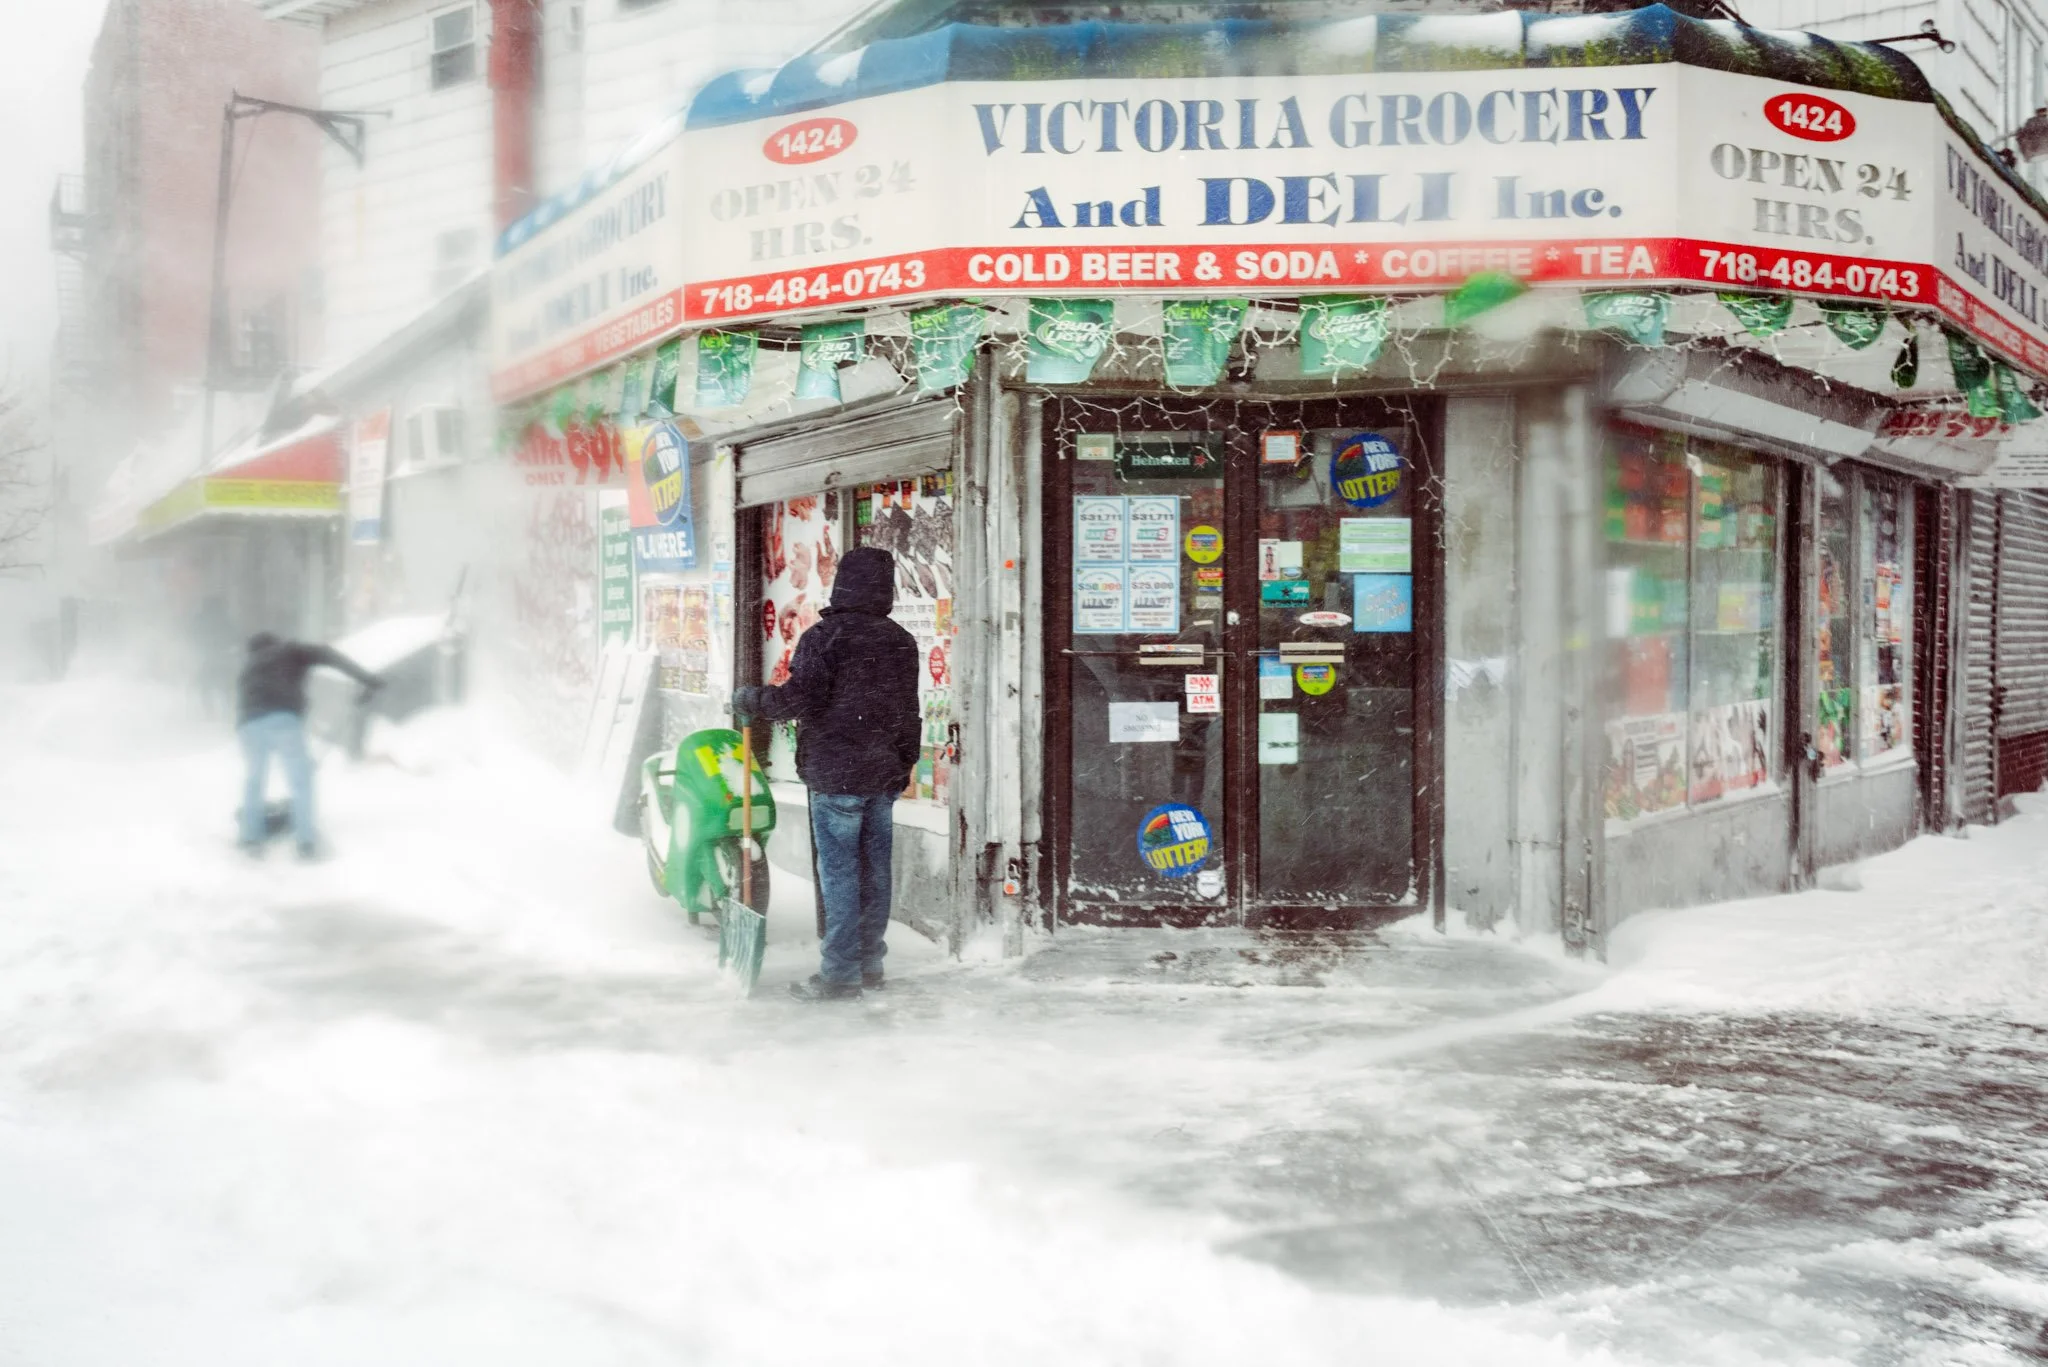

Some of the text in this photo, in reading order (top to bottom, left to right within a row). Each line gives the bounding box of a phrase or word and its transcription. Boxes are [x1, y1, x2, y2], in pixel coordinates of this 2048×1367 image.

[973, 86, 1659, 158] VICTORIA GROCERY
[1778, 101, 1844, 136] 1424
[777, 123, 845, 158] 1424
[1710, 142, 1913, 202] OPEN 24
[709, 160, 918, 223] OPEN 24
[1010, 171, 1624, 229] And DELI Inc.
[749, 213, 874, 262] HRS.
[1752, 197, 1875, 247] HRS.
[967, 244, 1655, 284] COLD BEER & SODA COFFEE TEA
[1699, 248, 1920, 297] 718-484-0743
[701, 259, 926, 316] 718-484-0743
[1612, 296, 1656, 308] BUD
[594, 298, 675, 355] VEGETABLES
[1605, 305, 1657, 318] LIGHT
[818, 341, 851, 354] BUD
[1362, 441, 1390, 454] NEW
[1366, 454, 1399, 472] YORK
[1337, 470, 1401, 501] LOTTERY
[1168, 810, 1196, 824] NEW
[1172, 822, 1206, 841] YORK
[1146, 838, 1209, 869] LOTTERY
